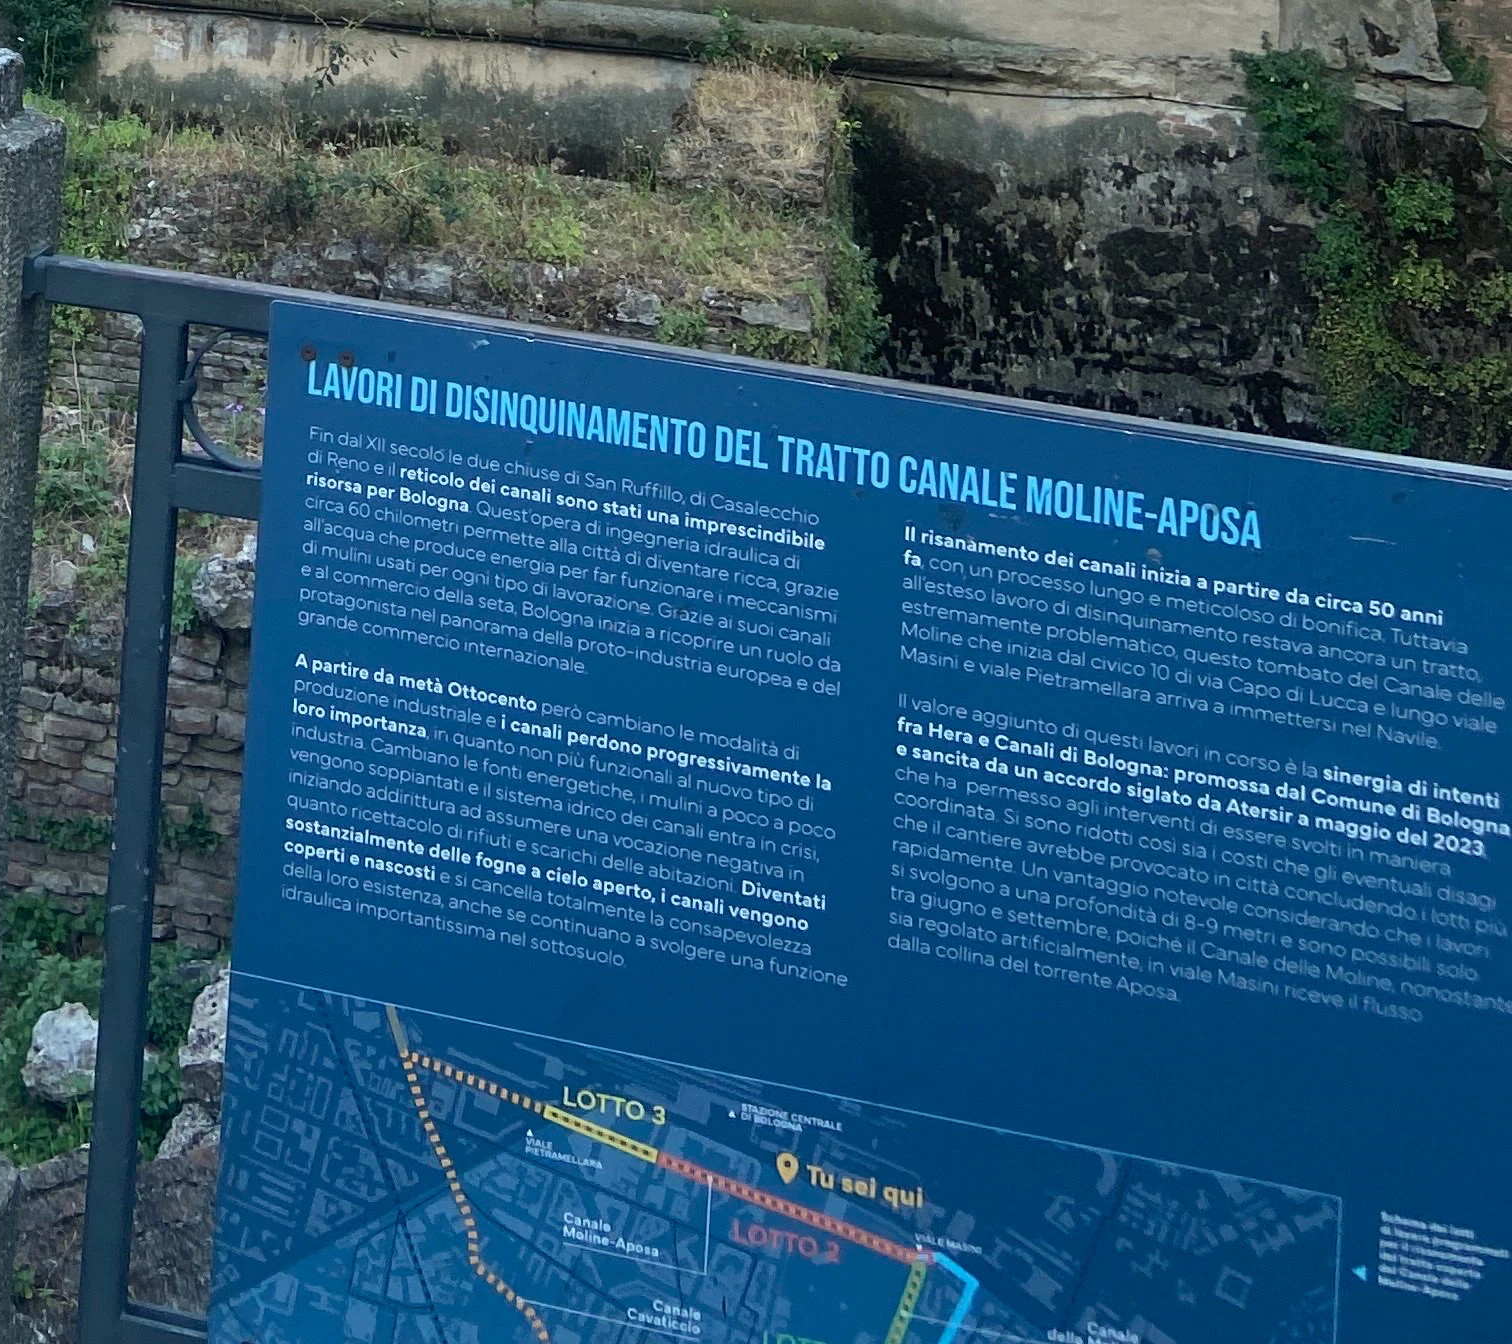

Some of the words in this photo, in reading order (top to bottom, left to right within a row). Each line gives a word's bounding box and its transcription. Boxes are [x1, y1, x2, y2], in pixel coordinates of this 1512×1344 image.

[308, 360, 402, 408] LAVORI
[410, 376, 437, 414] DI
[446, 382, 706, 458] DISINQUINAMENTO
[715, 426, 768, 470] DEL
[778, 435, 889, 488] TRATTO
[900, 456, 1017, 510] CANALE
[1026, 476, 1262, 548] MOLINE-APOSA
[307, 472, 362, 494] risorsa
[367, 485, 395, 500] per
[310, 426, 334, 443] Fin
[338, 432, 362, 448] dal
[390, 443, 445, 462] secolo
[449, 449, 462, 465] le
[467, 454, 500, 471] due
[504, 460, 560, 481] chiuse
[564, 470, 579, 485] di
[585, 473, 616, 491] San
[690, 491, 705, 506] di
[711, 494, 819, 525] Casalecchio
[305, 496, 344, 513] circa
[349, 502, 370, 518] 60
[374, 507, 458, 533] chilometri
[400, 468, 464, 488] reticolo
[469, 476, 495, 494] dei
[500, 485, 551, 503] canali
[556, 495, 598, 511] sono
[603, 501, 641, 519] stati
[647, 510, 679, 525] una
[685, 512, 825, 550] imprescindibile
[905, 526, 915, 542] Il
[921, 530, 1039, 562] risanamento
[1044, 550, 1073, 568] dei
[1079, 559, 1136, 578] canali
[1142, 564, 1191, 587] inizia
[1197, 578, 1207, 589] a
[1214, 580, 1280, 600] partire
[1285, 588, 1309, 605] da
[1315, 596, 1363, 613] circa
[1369, 600, 1395, 618] 50
[1400, 609, 1443, 626] anni
[295, 654, 308, 668] A
[312, 660, 369, 679] partire
[374, 668, 394, 684] da
[400, 676, 443, 694] metà
[448, 682, 537, 711] Ottocento
[293, 698, 325, 718] loro
[501, 714, 505, 729] i
[510, 721, 562, 740] canali
[567, 731, 642, 754] perdono
[647, 746, 811, 786] progressivamente
[816, 773, 831, 791] la
[896, 745, 907, 756] e
[912, 748, 979, 769] sancita
[985, 757, 1008, 774] da
[1015, 765, 1038, 780] un
[1043, 771, 1121, 794] accordo
[1127, 785, 1192, 806] siglato
[1197, 794, 1221, 811] da
[1226, 799, 1293, 823] Atersir
[1298, 814, 1309, 827] a
[1315, 817, 1391, 840] maggio
[1396, 827, 1427, 846] del
[897, 716, 923, 735] fra
[929, 722, 973, 744] Hera
[979, 735, 989, 746] e
[995, 735, 1054, 759] Canali
[1060, 746, 1077, 762] di
[1084, 749, 1168, 778] Bologna:
[1174, 769, 1270, 795] promossa
[1275, 782, 1305, 801] dal
[1311, 788, 1396, 816] Comune
[1401, 804, 1420, 820] di
[1427, 807, 1511, 836] Bologna
[1323, 766, 1402, 793] sinergia
[1408, 780, 1427, 796] di
[1433, 783, 1500, 809] intenti
[284, 841, 344, 863] coperti
[350, 855, 359, 865] e
[365, 857, 435, 881] nascosti
[286, 818, 424, 854] sostanzialmente
[429, 843, 471, 864] delle
[476, 852, 526, 875] fogne
[531, 867, 541, 878] a
[546, 870, 588, 887] cielo
[593, 879, 656, 903] aperto,
[661, 888, 665, 903] i
[671, 895, 724, 914] canali
[728, 906, 808, 930] vengono
[742, 880, 825, 910] Diventati
[563, 1085, 645, 1121] LOTTO
[651, 1105, 666, 1126] 3
[806, 1164, 834, 1190] Tu
[841, 1176, 876, 1199] sei
[882, 1186, 924, 1209] qui
[562, 1225, 659, 1258] Moline-Aposa
[563, 1212, 612, 1233] Canale
[731, 1219, 817, 1257] LOTTO
[627, 1307, 701, 1335] Cavaticcio
[652, 1299, 701, 1321] Canale
